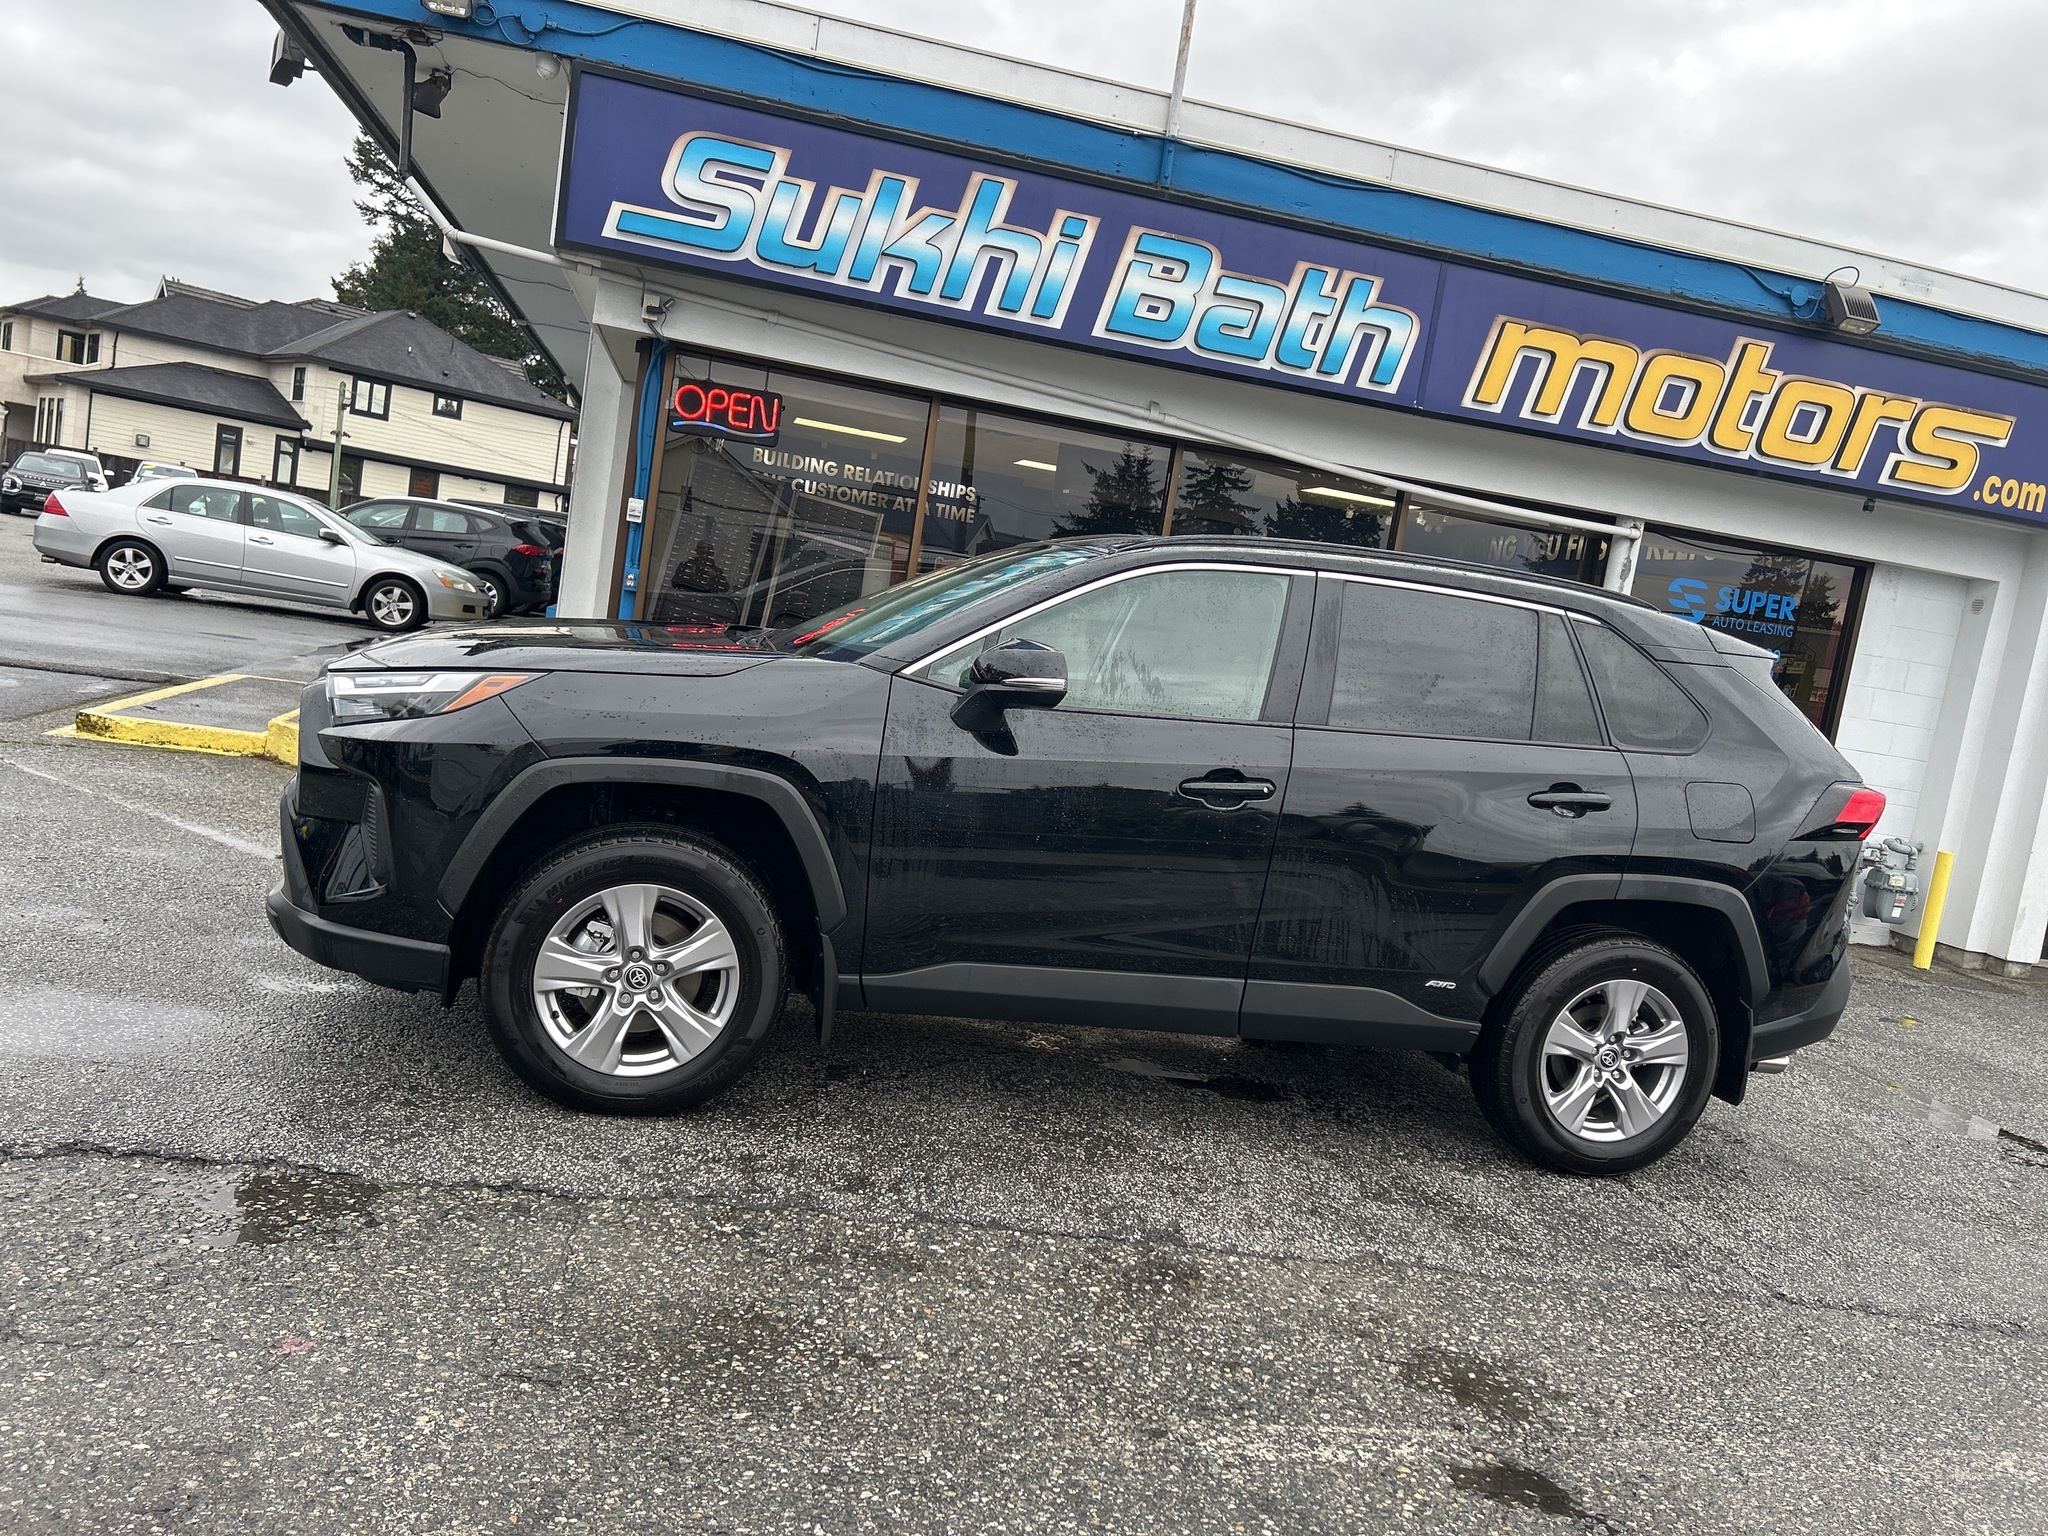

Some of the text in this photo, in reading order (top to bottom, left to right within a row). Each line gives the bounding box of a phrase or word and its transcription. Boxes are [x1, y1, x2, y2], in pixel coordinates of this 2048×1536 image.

[601, 131, 1099, 329] Sukhi
[1092, 225, 1421, 394] Bath
[674, 384, 779, 432] OPEN
[752, 447, 839, 477] BUILDING
[791, 478, 888, 509] CUSTOMER
[892, 496, 917, 513] AT
[936, 502, 976, 524] TIME
[1714, 586, 1797, 622] SUPER
[1712, 616, 1794, 638] AUTO LEASING
